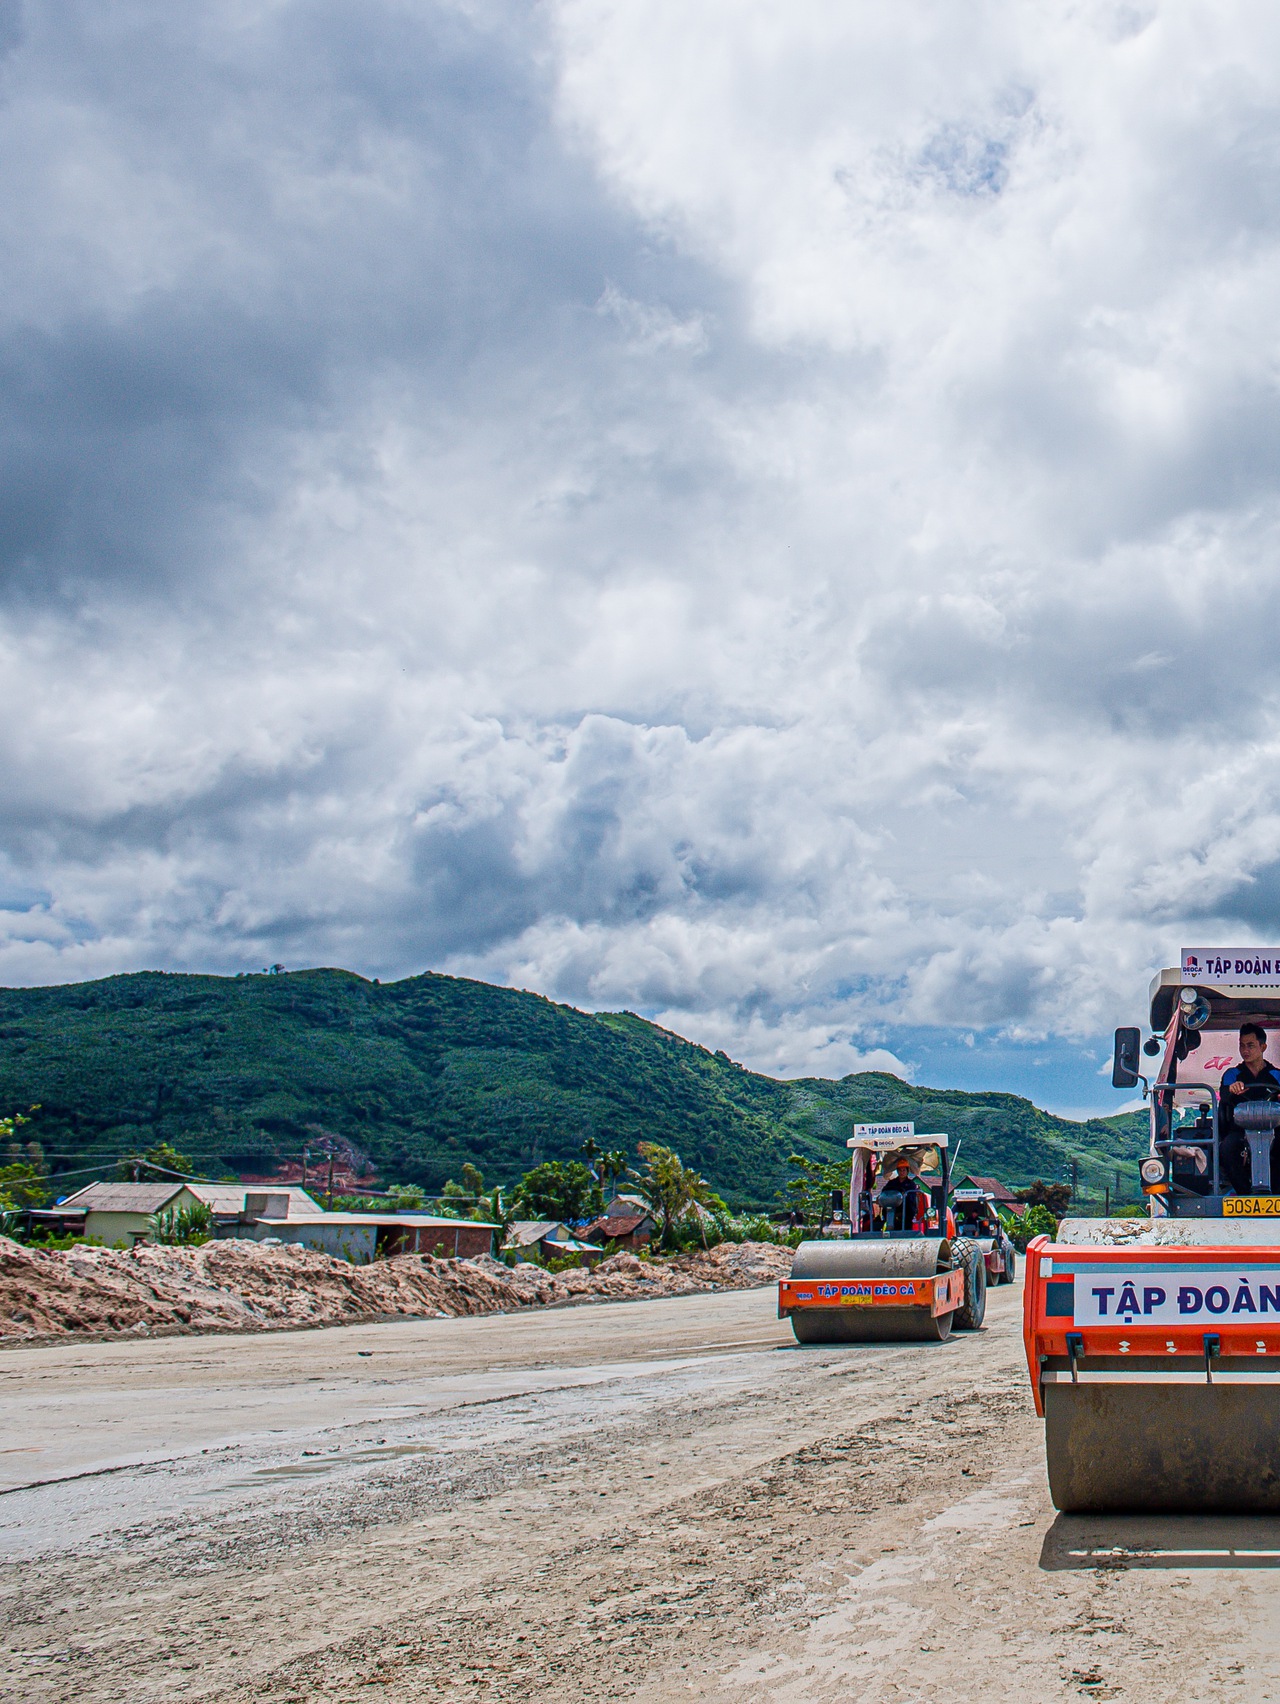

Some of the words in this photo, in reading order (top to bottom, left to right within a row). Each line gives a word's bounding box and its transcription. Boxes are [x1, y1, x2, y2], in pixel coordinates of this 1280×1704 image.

[1206, 956, 1231, 978] TẬP
[1235, 956, 1271, 974] ĐOÀN
[817, 1284, 838, 1298] TẬP
[841, 1284, 872, 1295] ĐOÀN
[874, 1283, 897, 1295] ĐÈO
[899, 1283, 915, 1295] CẢ
[1092, 1280, 1167, 1323] TẬP
